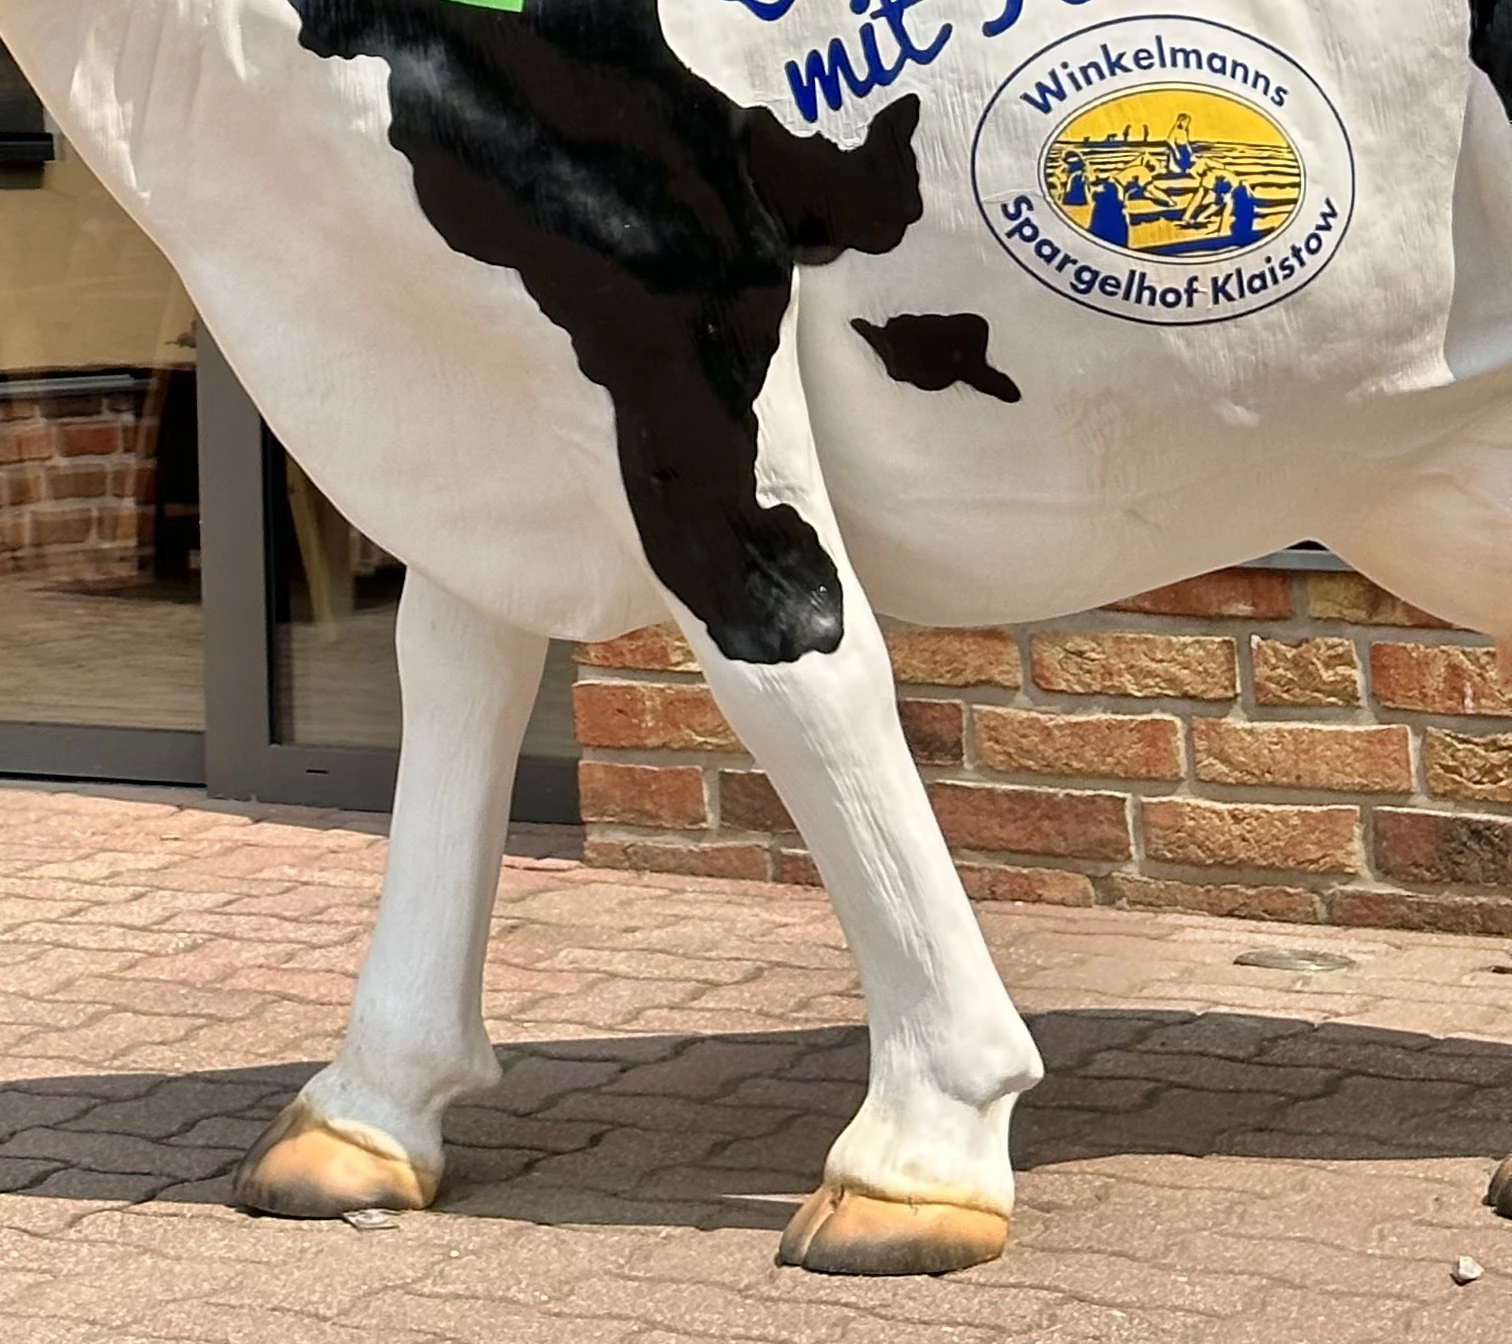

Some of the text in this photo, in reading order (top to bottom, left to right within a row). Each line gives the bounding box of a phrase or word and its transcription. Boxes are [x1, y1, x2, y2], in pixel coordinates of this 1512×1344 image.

[1020, 35, 1289, 115] Winkelmanns
[1000, 194, 1340, 309] Spargelhof Klaistow
